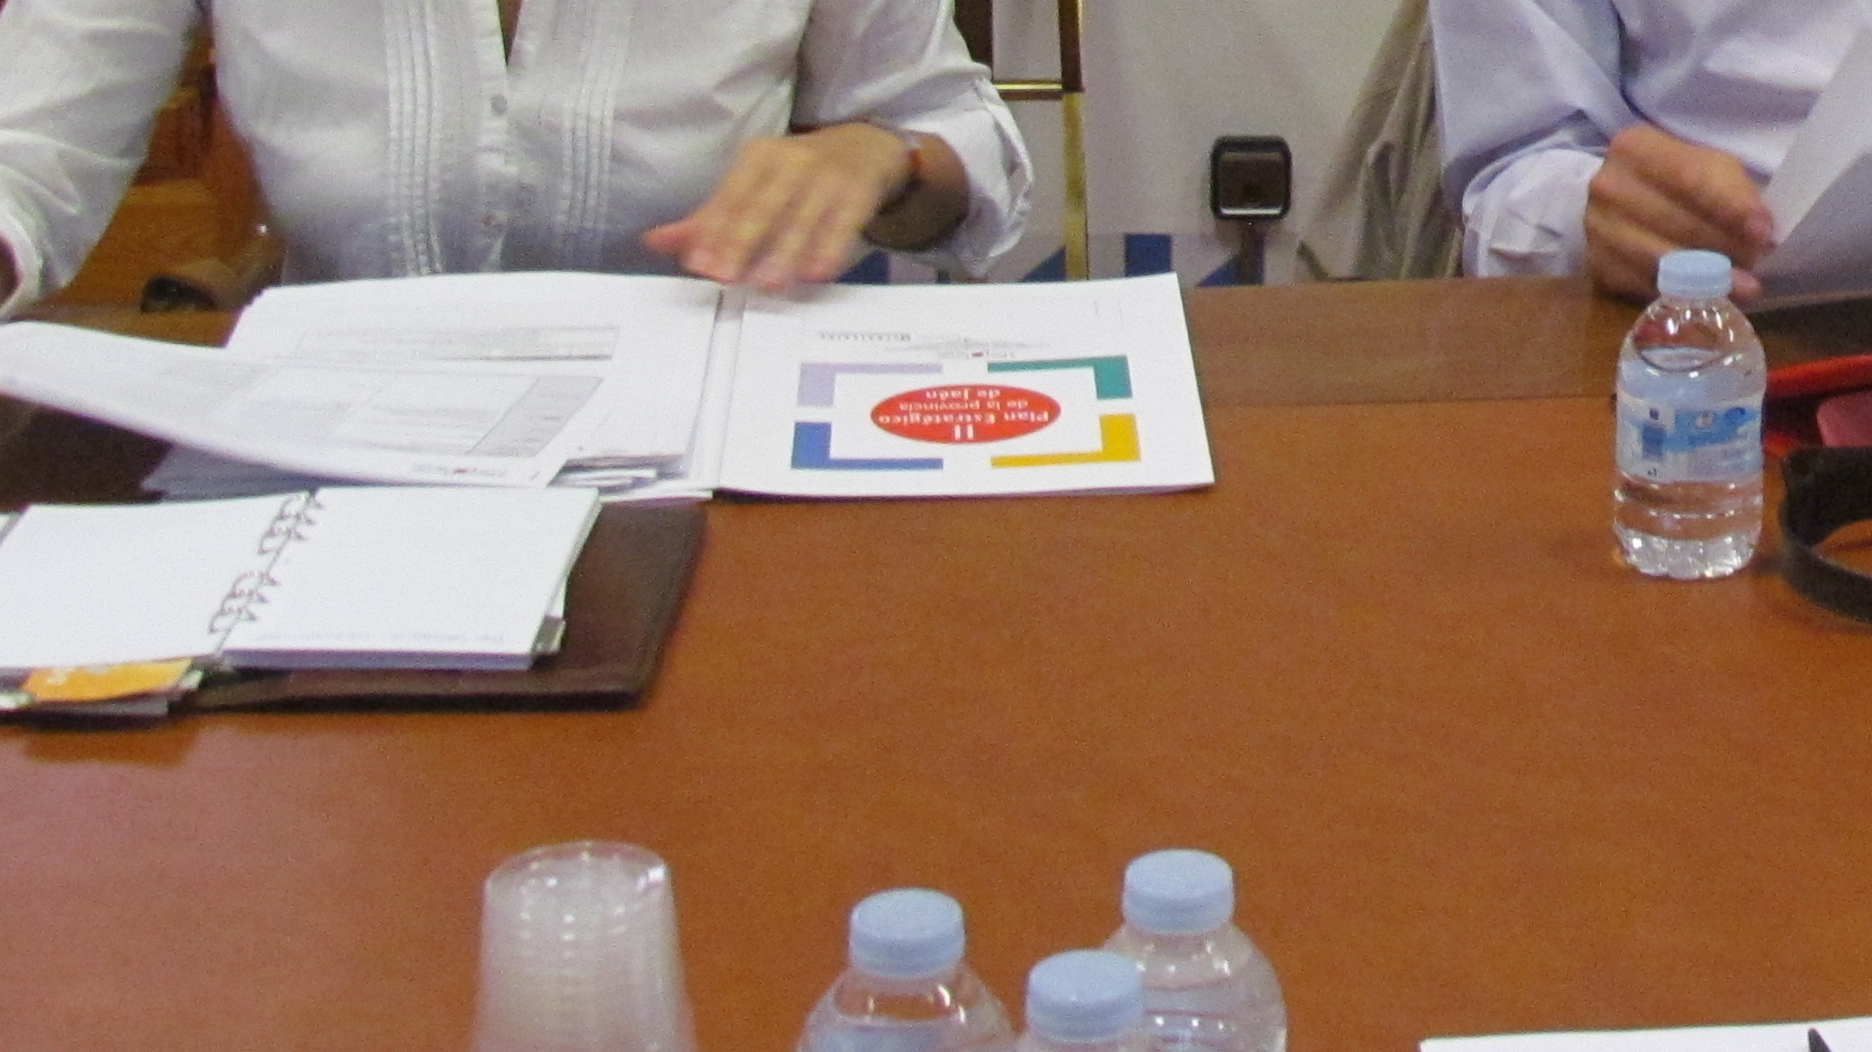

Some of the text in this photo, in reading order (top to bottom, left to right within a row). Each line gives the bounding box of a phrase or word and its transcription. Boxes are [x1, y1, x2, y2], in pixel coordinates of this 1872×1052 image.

[925, 387, 1001, 401] de Jaén
[899, 400, 1029, 412] de la provincia
[878, 410, 1049, 425] Plan Estratégico
[953, 424, 975, 440] II
